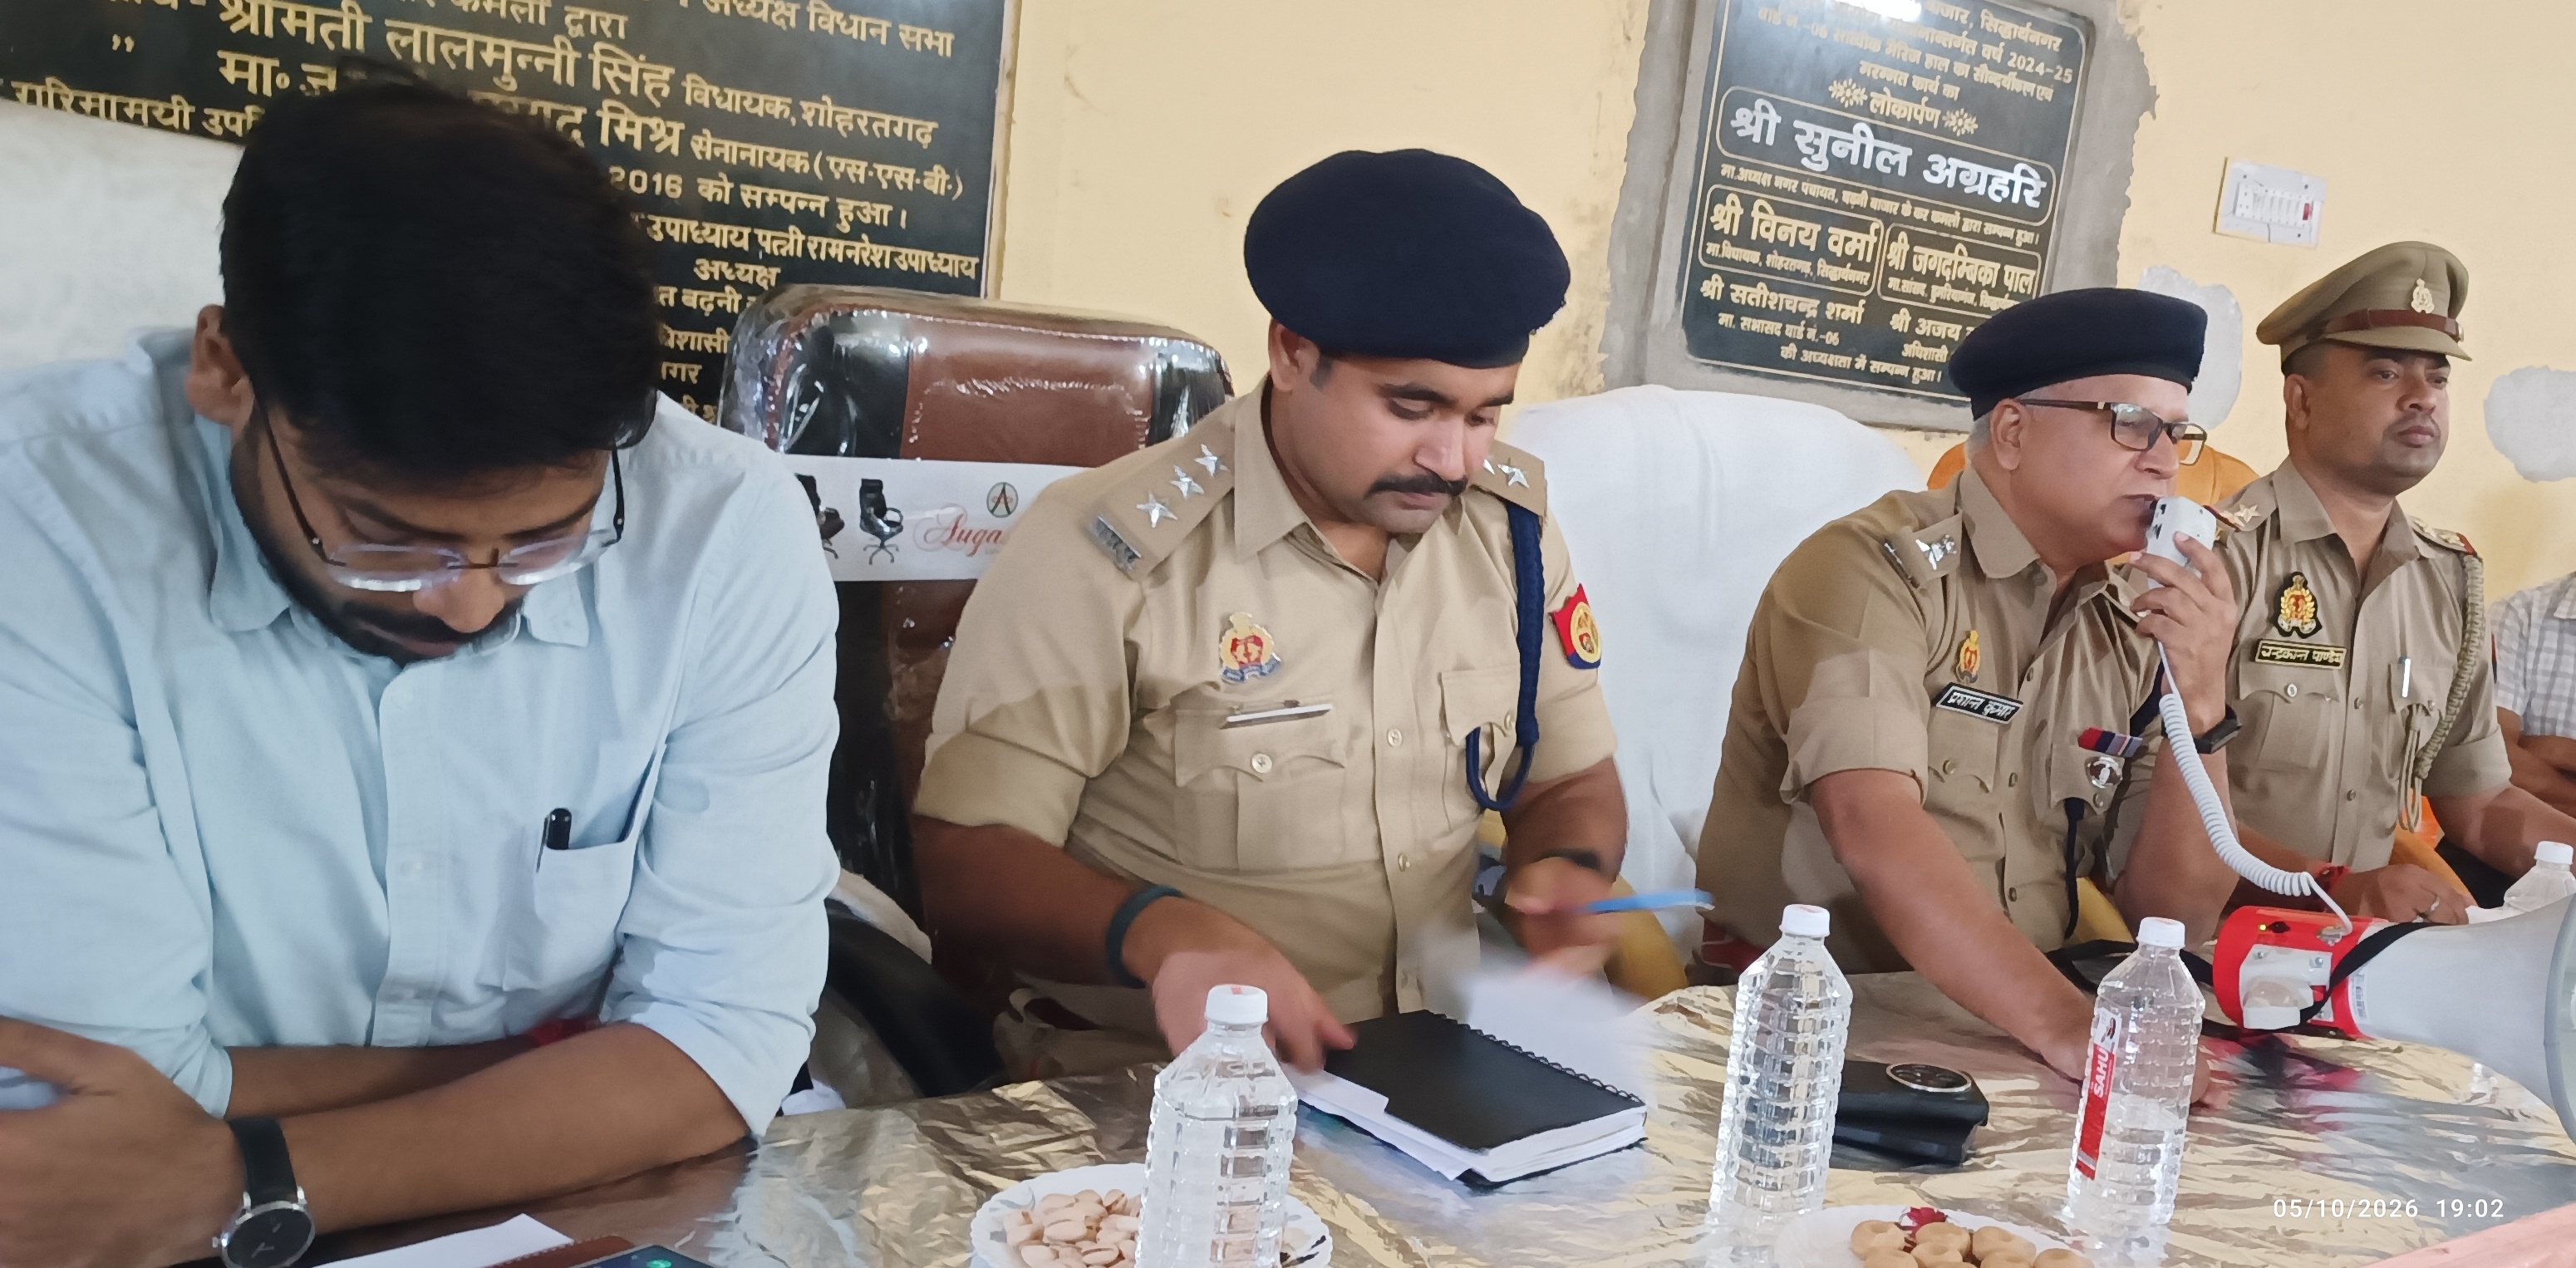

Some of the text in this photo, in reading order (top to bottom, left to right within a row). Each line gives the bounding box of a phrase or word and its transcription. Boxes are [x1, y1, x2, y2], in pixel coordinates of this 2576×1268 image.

[564, 6, 628, 39] द्वारा
[806, 0, 892, 46] विधान
[898, 23, 955, 57] सभा
[1925, 53, 1950, 72] हाल
[1954, 61, 1970, 78] का
[1982, 42, 2005, 63] वर्ष
[2008, 52, 2073, 83] 2024-25
[385, 18, 582, 91] लालमुन्नी
[588, 42, 676, 108] सिंह
[799, 94, 939, 149] शोहरतगढ़
[1912, 75, 1940, 95] कार्य
[1943, 83, 1960, 101] का
[1871, 86, 1940, 128] लोकार्पण
[596, 99, 686, 157] मिश्र
[691, 128, 809, 174] सेनानायक
[1731, 98, 2047, 208] श्री सुनील अग्रहरि
[697, 171, 734, 204] को
[740, 183, 829, 218] सम्पन्न
[1774, 175, 1799, 193] नगर
[646, 213, 751, 251] उपाध्याय
[1710, 194, 1879, 263] श्री विनय वर्मा
[693, 258, 781, 291] अध्यक्ष
[1887, 231, 2036, 294] श्री जगदम्बिका पाल
[681, 284, 742, 317] बढ़नी
[1700, 273, 1866, 323] श्री सतीशचन्द्र शर्मा
[1741, 316, 1782, 337] सभासद
[1890, 308, 1911, 332] श्री
[1915, 318, 1962, 342] अजय
[1781, 343, 1797, 360] की
[1855, 353, 1866, 371] में
[1871, 360, 1910, 378] सम्पन्न
[2094, 1047, 2109, 1098] SAHU
